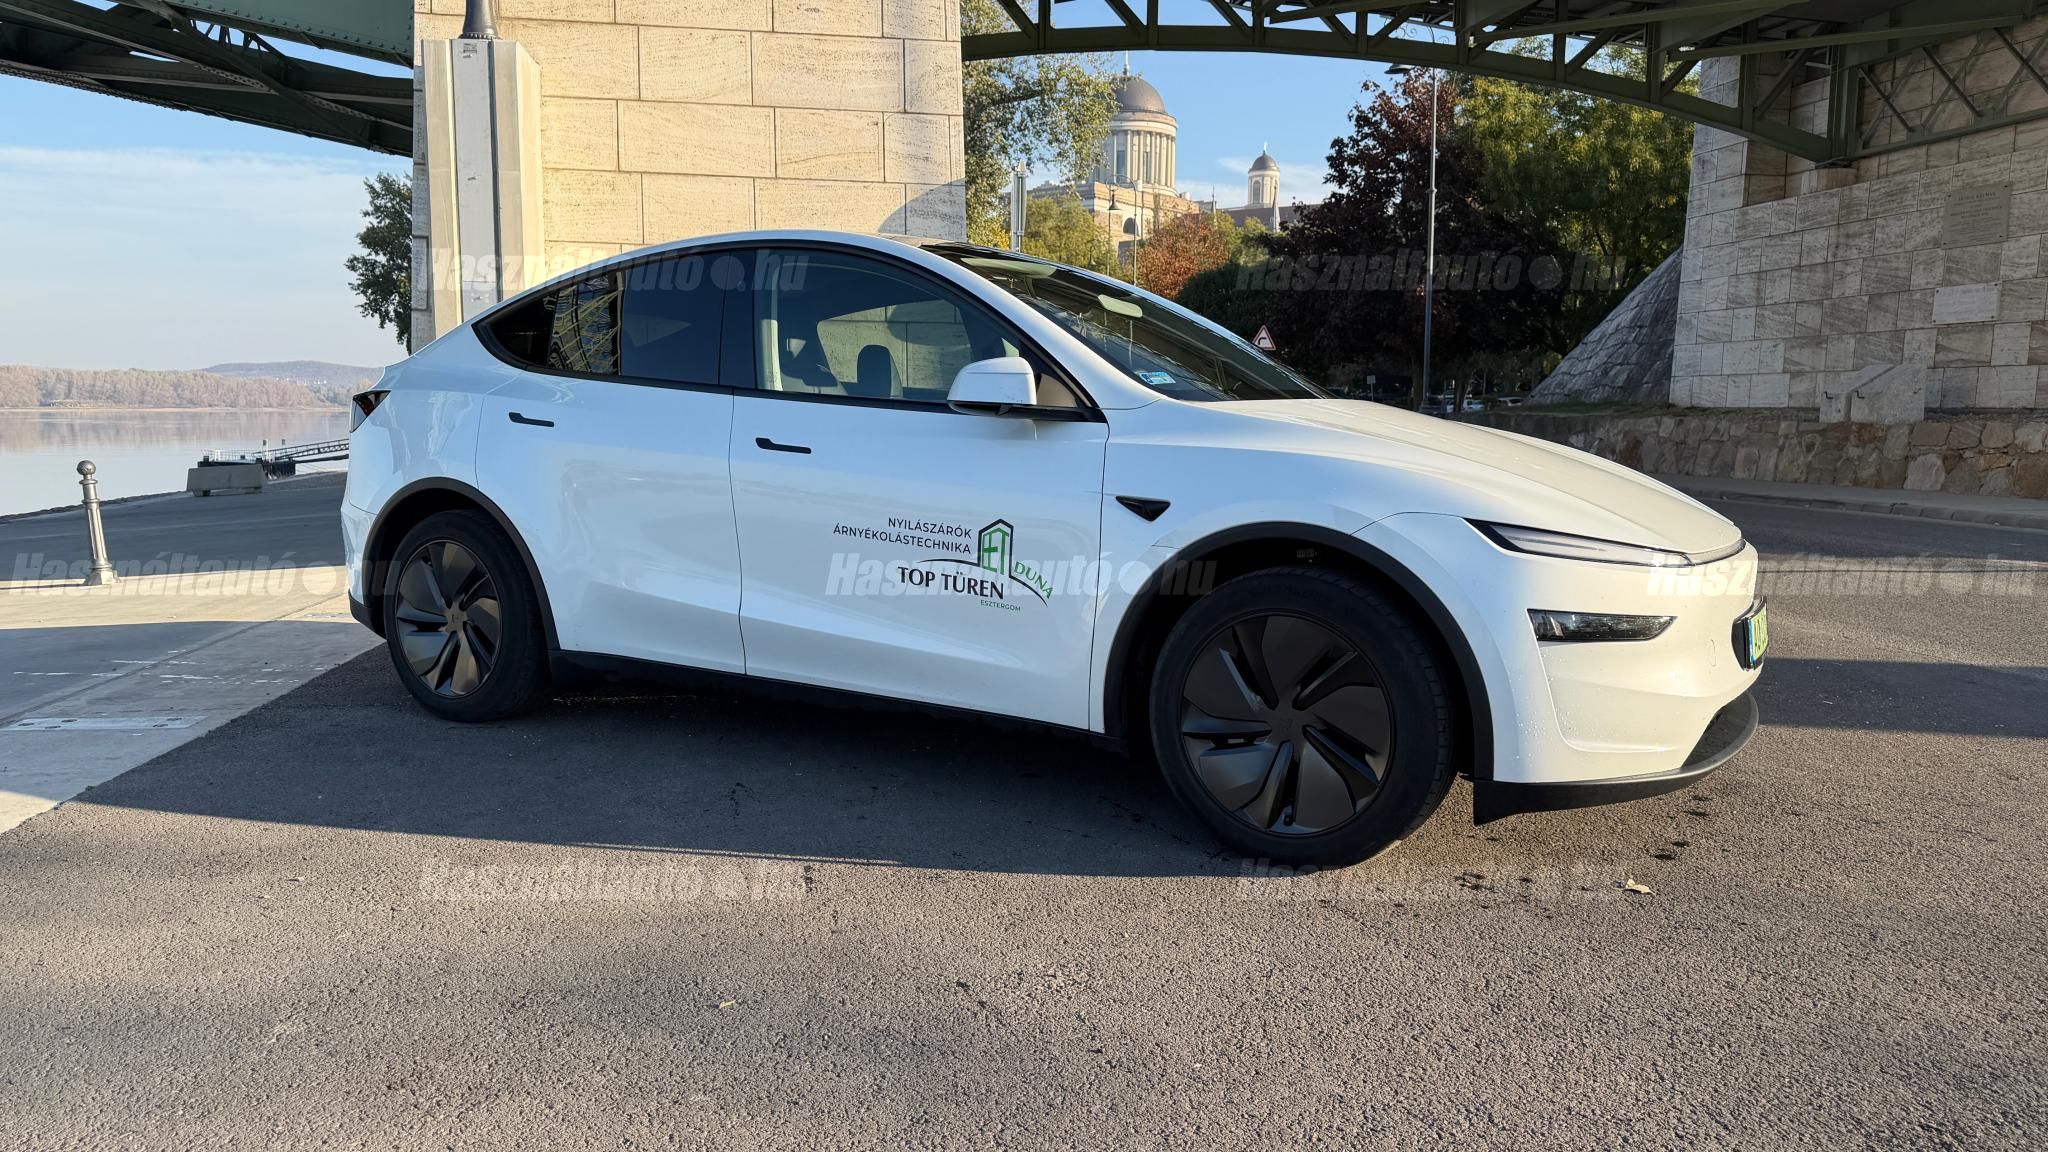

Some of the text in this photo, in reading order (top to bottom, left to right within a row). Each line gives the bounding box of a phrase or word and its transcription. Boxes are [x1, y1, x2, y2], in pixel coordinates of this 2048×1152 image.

[833, 523, 971, 554] ÁRNYÉKOLÁSTECHNIKA
[888, 517, 972, 539] NYILÁSZÁRÓK
[897, 566, 1004, 600] TOP TÜREN
[1014, 560, 1054, 599] DUNA
[980, 600, 1021, 612] ESZTERGOM
